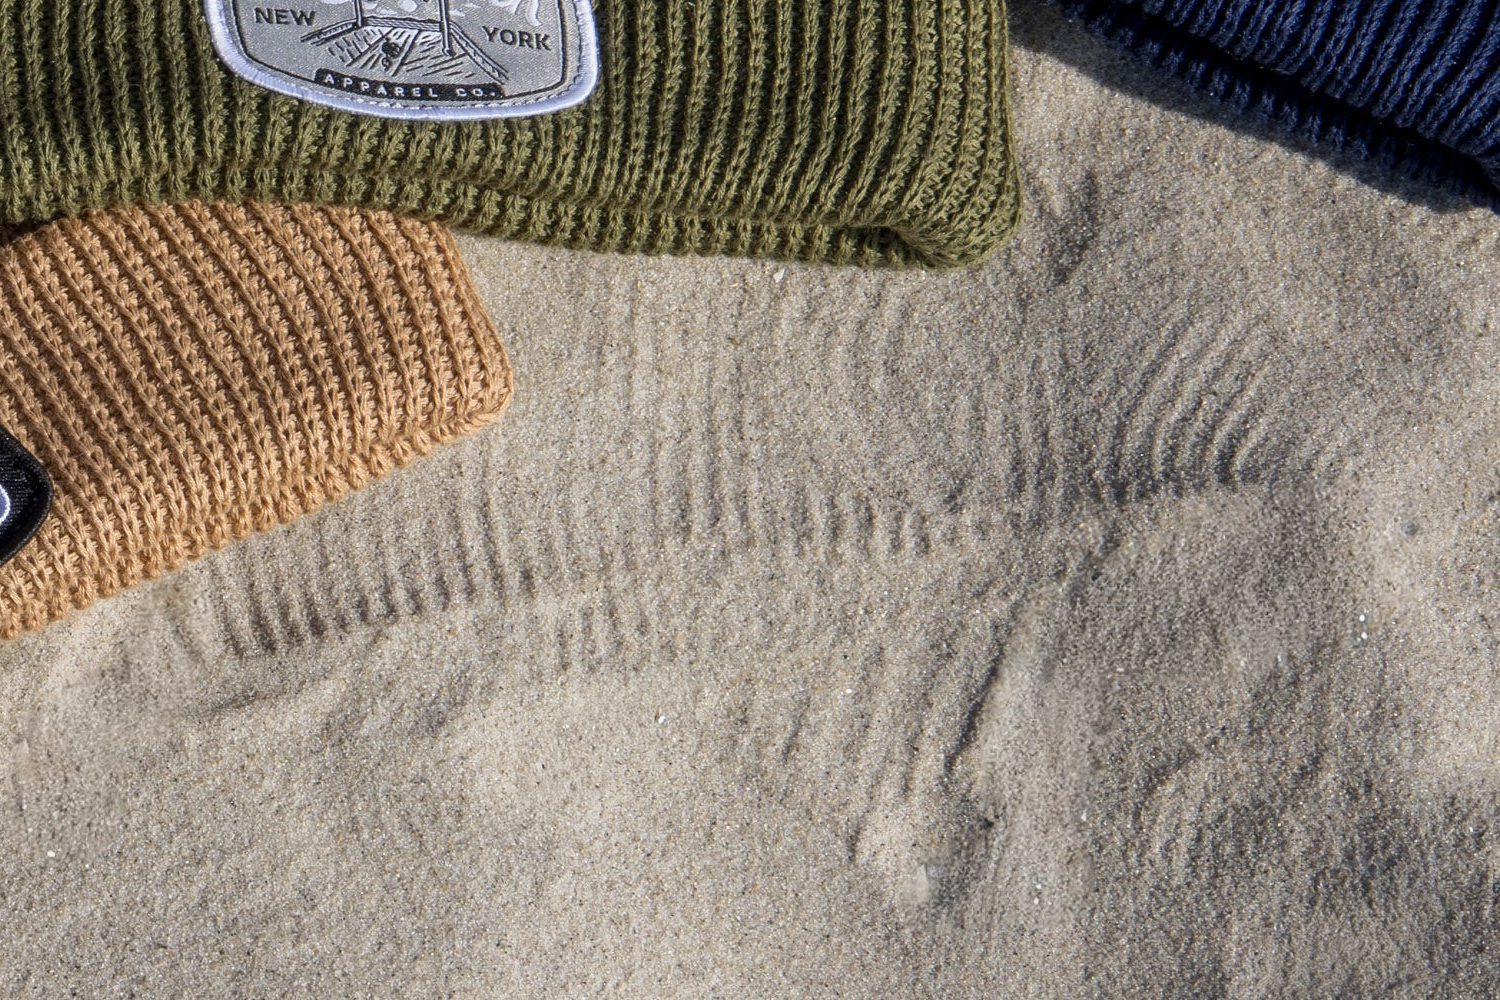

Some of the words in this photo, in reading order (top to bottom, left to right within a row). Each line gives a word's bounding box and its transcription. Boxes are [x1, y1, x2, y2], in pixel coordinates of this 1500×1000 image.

[254, 6, 317, 27] NEW
[481, 25, 553, 52] YORK
[323, 73, 439, 99] APPAREL
